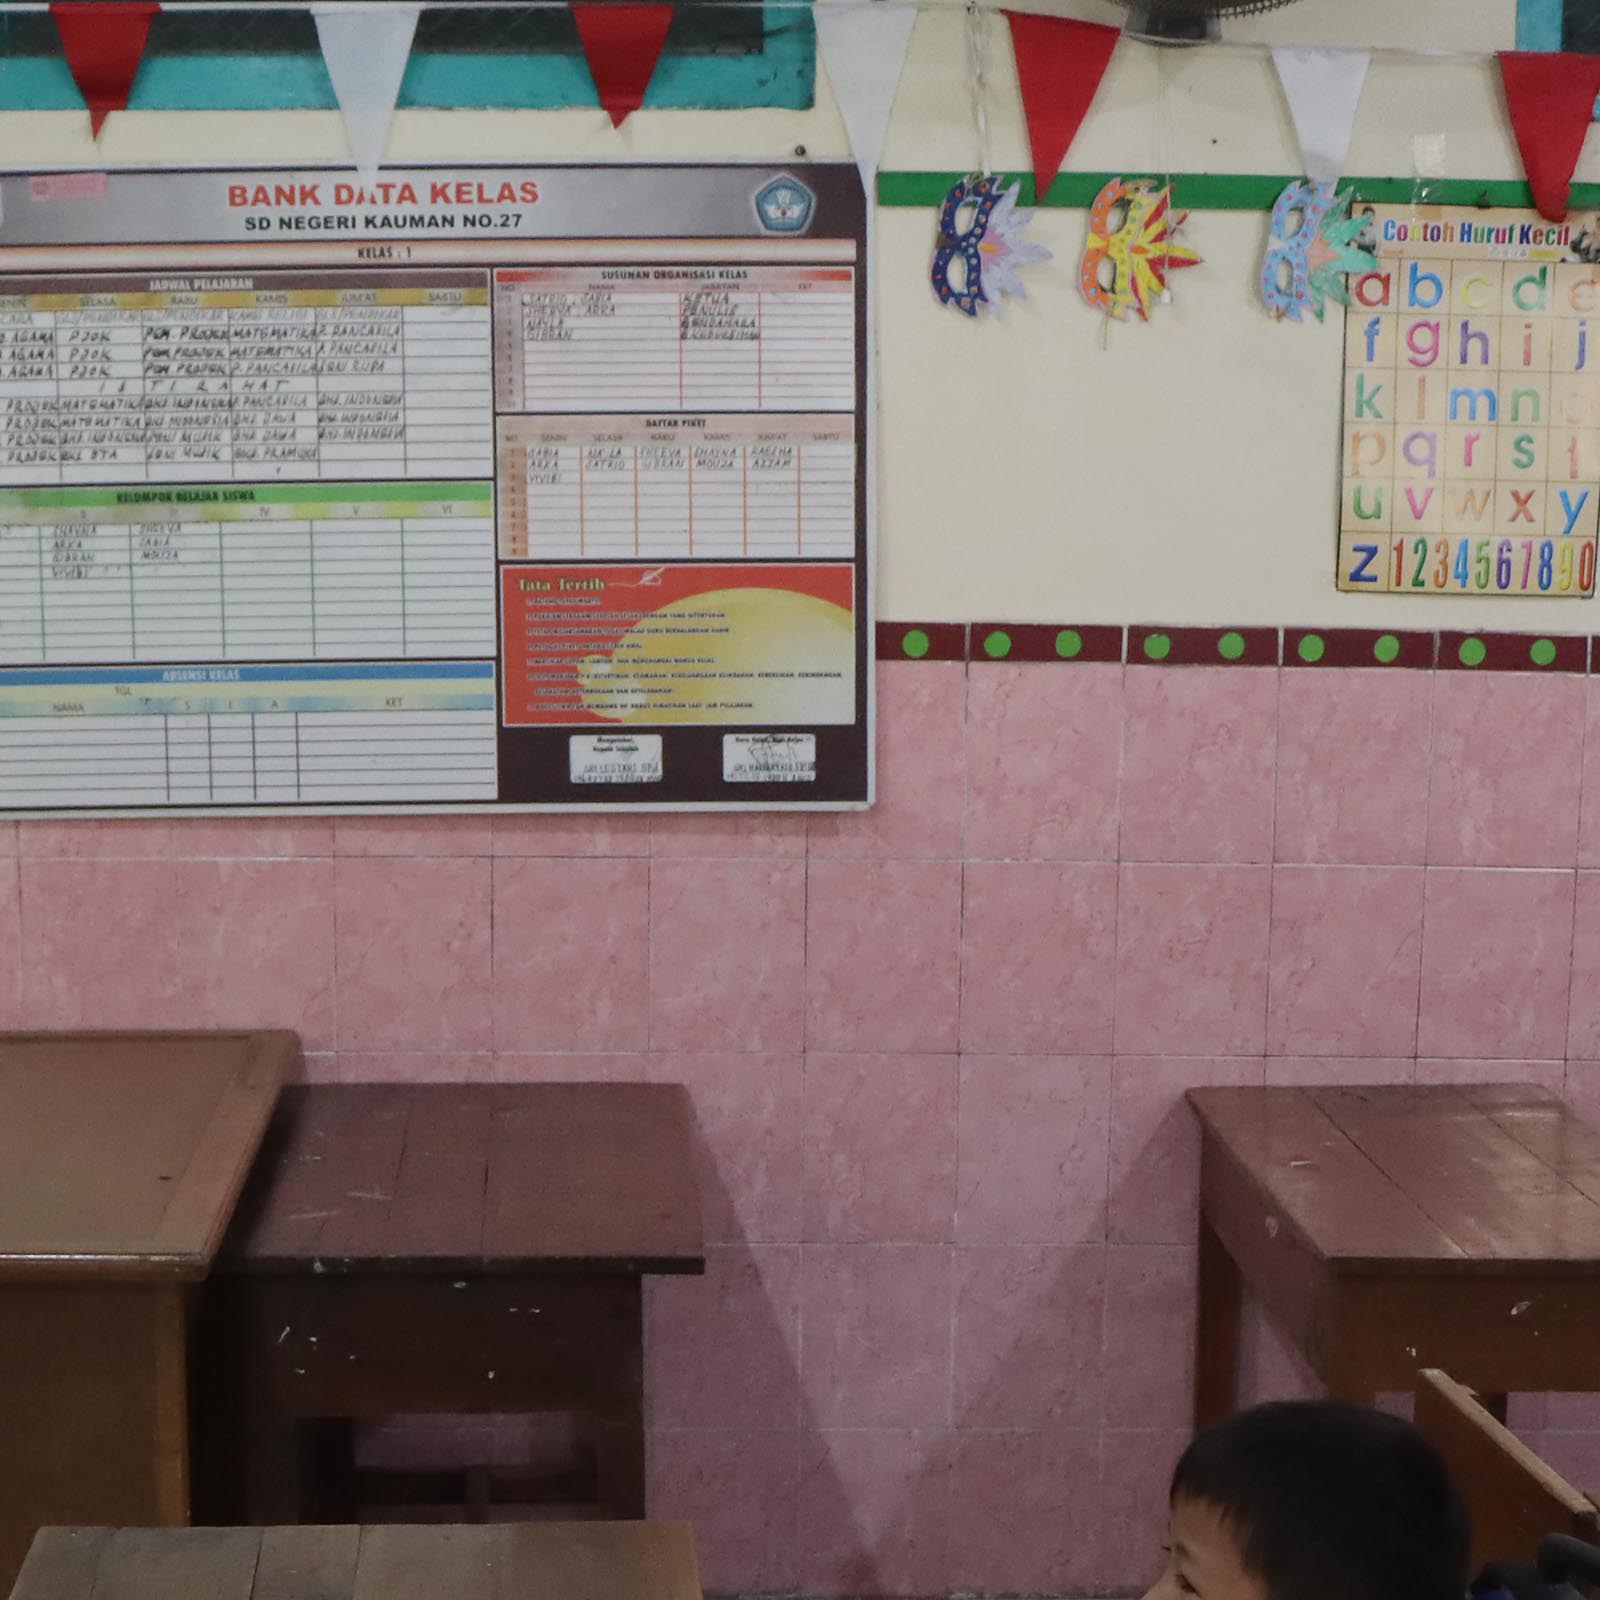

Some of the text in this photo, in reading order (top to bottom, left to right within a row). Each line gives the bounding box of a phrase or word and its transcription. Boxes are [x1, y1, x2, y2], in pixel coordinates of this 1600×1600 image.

[228, 184, 320, 206] BANK
[431, 181, 539, 204] KELAS
[245, 214, 522, 231] SD NEGERI KAUMAN NO.27
[1383, 219, 1570, 245] Contoh Huruf Kecil
[358, 248, 392, 259] KELAS
[150, 279, 253, 290] JADWAL PELAJARAN
[602, 271, 747, 279] SUSUNAN ORGANISASI KELAS
[1356, 272, 1390, 307] a
[1408, 262, 1442, 308] b
[1461, 275, 1494, 309] c
[1512, 266, 1547, 311] d
[1364, 317, 1586, 370] f g h i j
[1355, 373, 1383, 419] k
[1449, 388, 1497, 421] m
[1510, 388, 1540, 421] n
[1351, 431, 1386, 476] p
[1402, 431, 1437, 478] q
[1464, 432, 1480, 466] r
[1513, 434, 1535, 468] s
[1353, 485, 1589, 534] u v w x y
[1349, 545, 1379, 582] z
[518, 578, 605, 591] Tata Tertib
